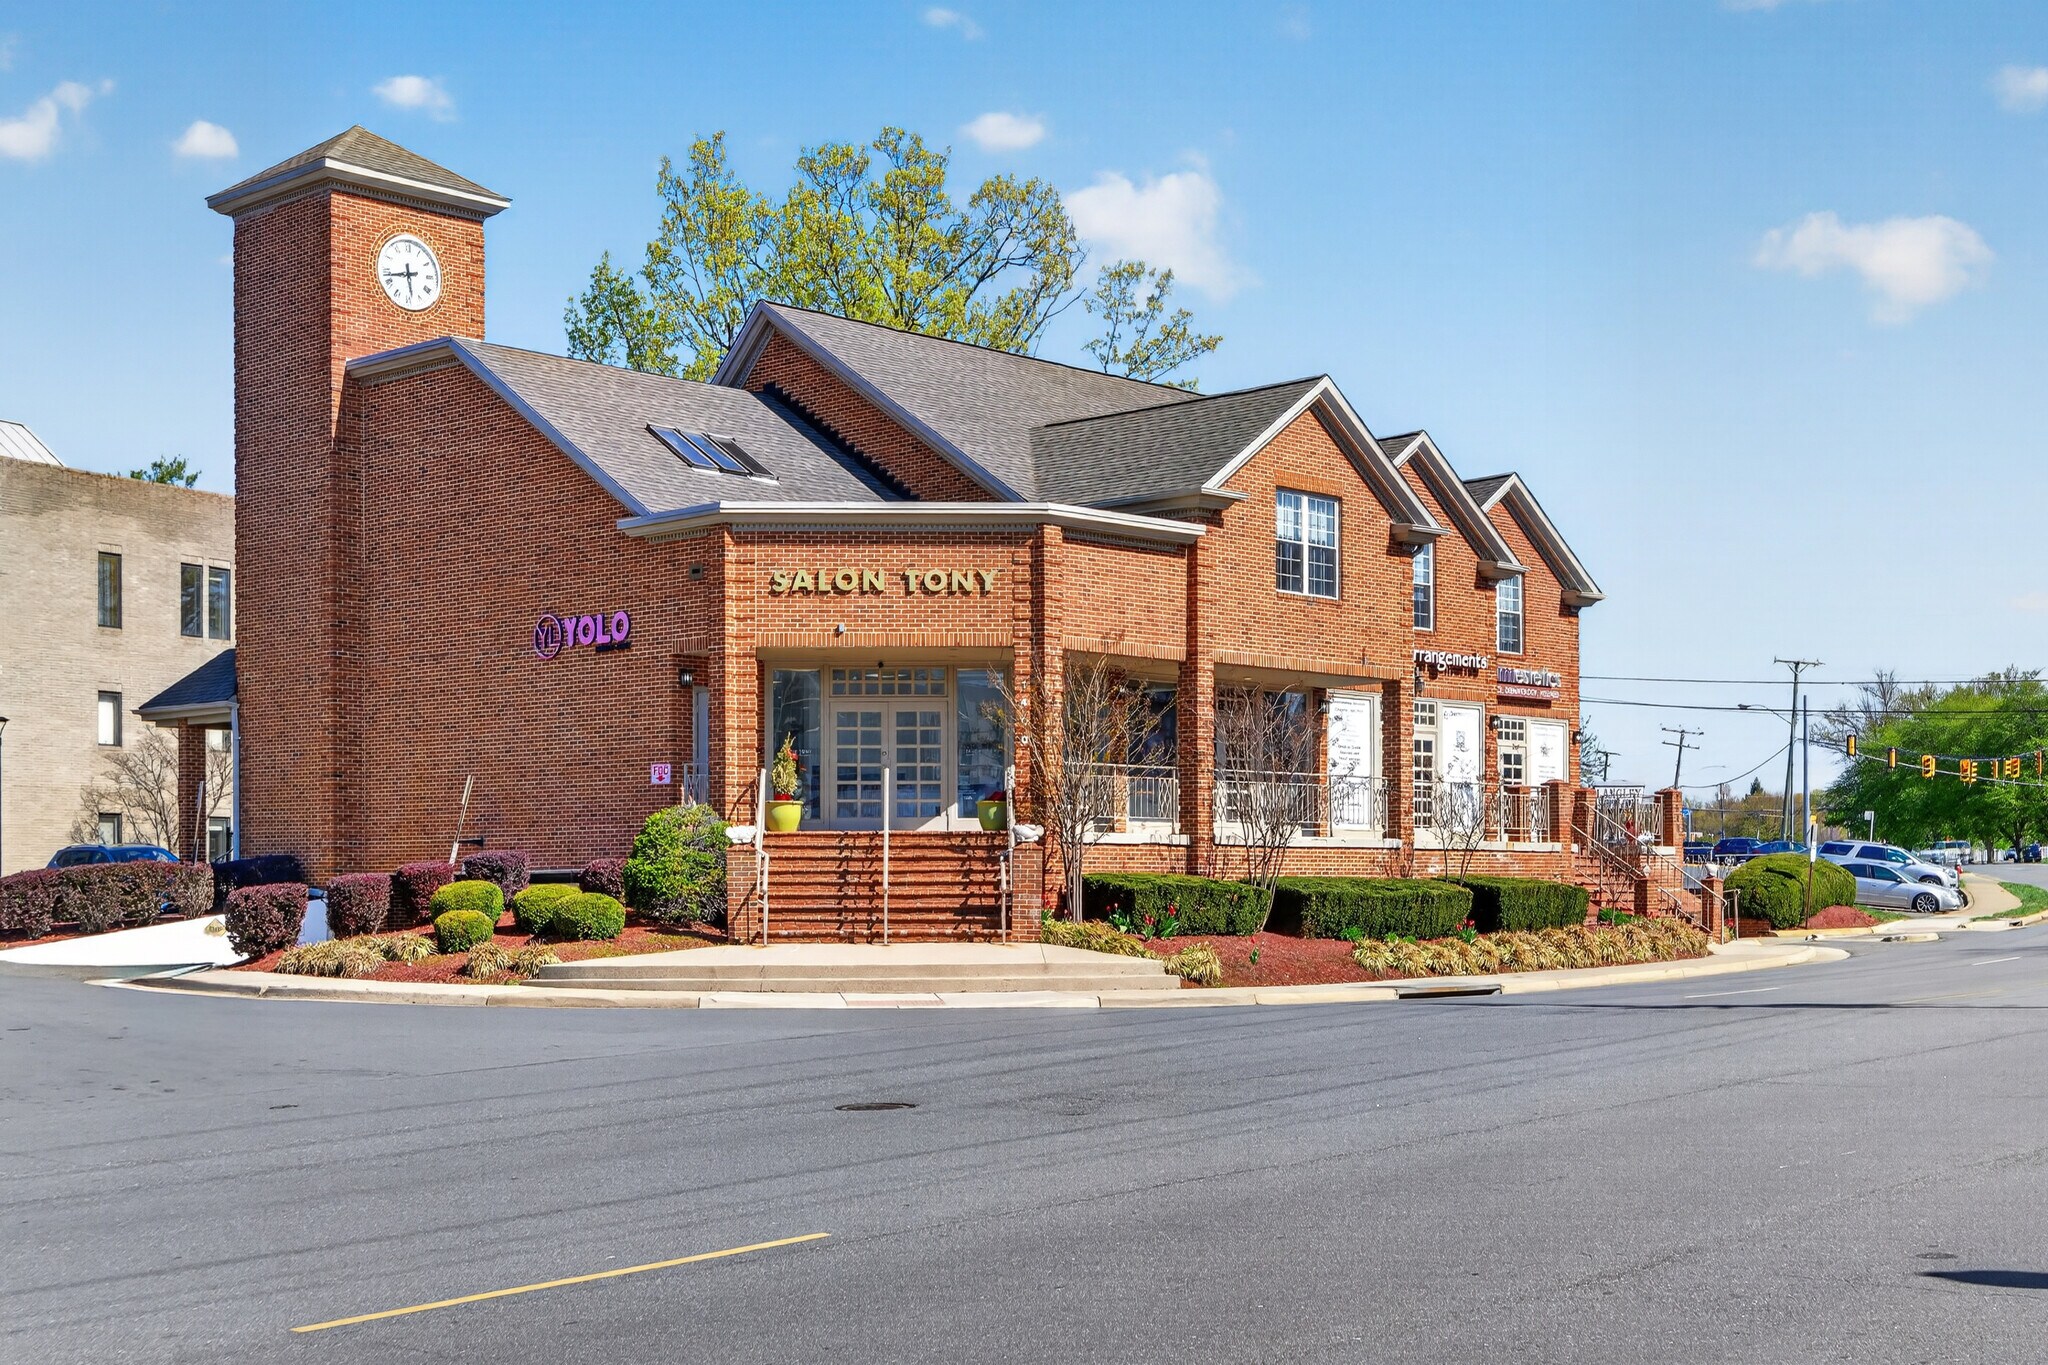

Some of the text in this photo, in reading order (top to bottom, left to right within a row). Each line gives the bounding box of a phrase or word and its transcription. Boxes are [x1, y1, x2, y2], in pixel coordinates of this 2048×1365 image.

[772, 568, 998, 592] SALON TONY
[564, 611, 630, 647] YOLO
[1413, 649, 1488, 671] rrangements
